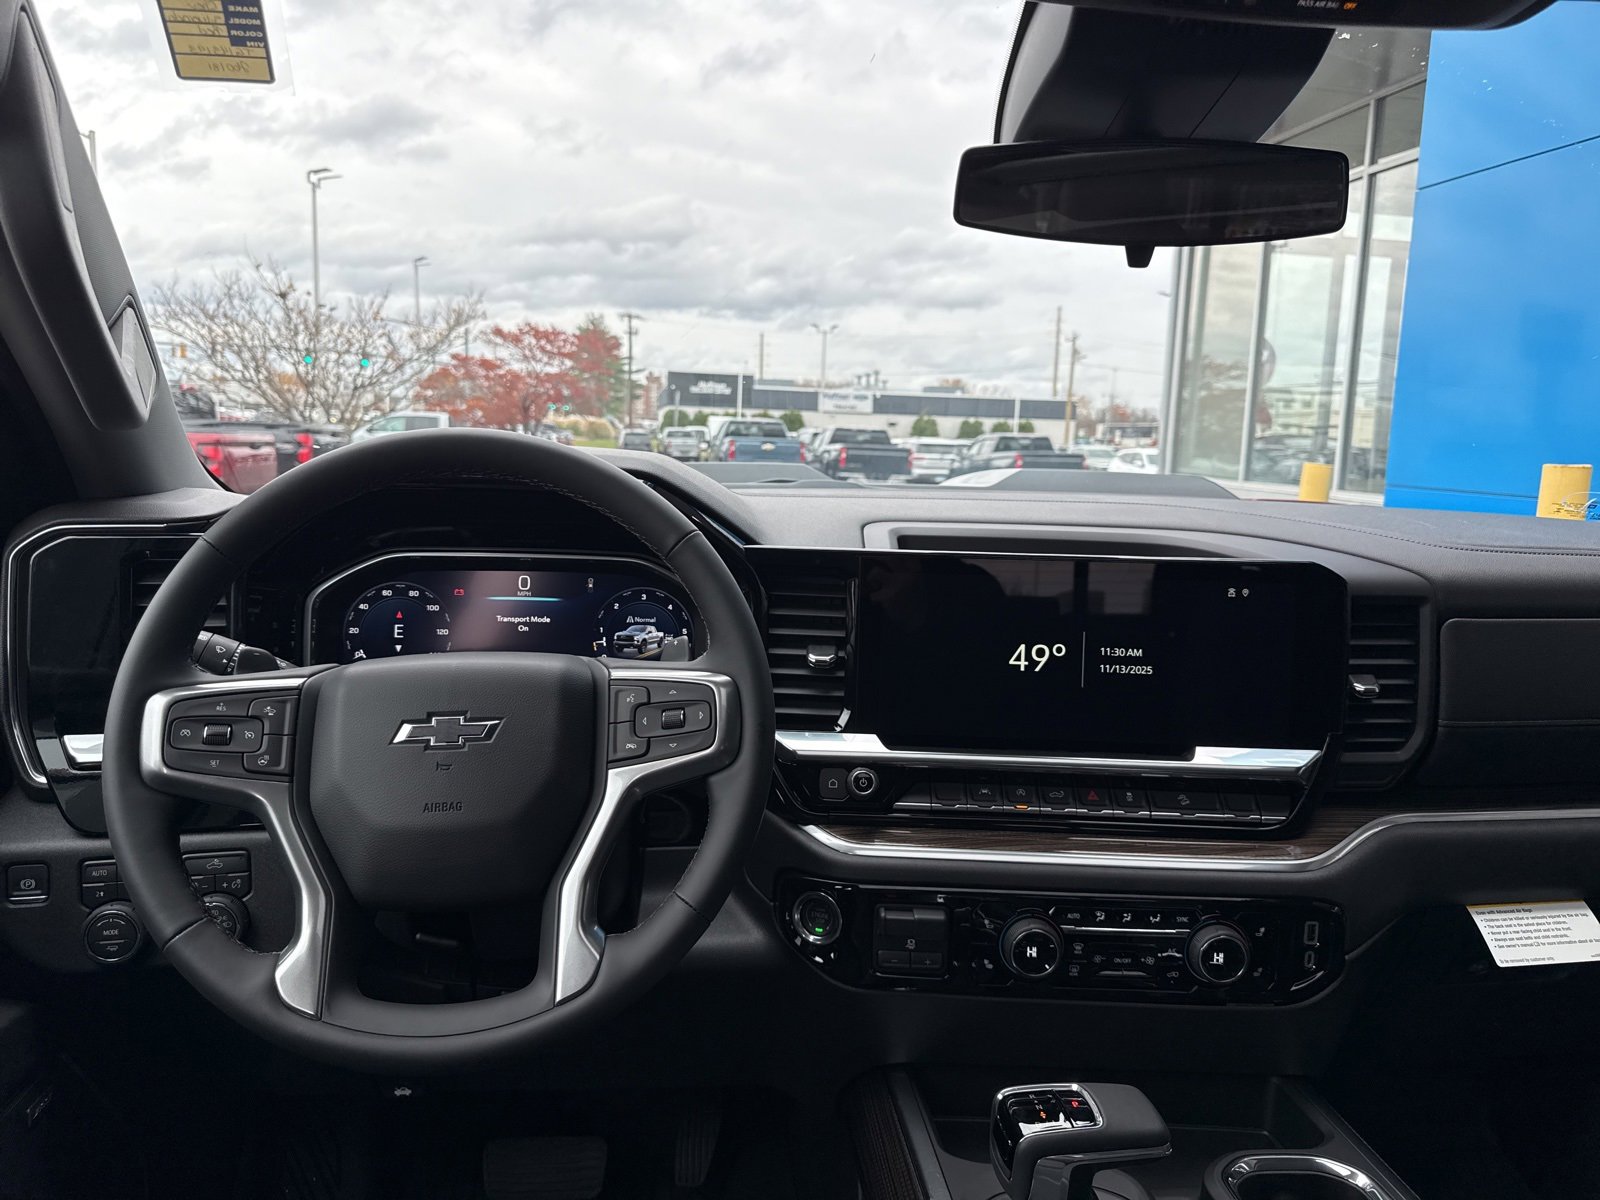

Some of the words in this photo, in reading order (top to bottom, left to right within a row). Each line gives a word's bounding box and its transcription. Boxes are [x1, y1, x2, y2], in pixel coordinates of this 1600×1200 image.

[518, 576, 530, 590] 0
[394, 624, 404, 638] E
[1100, 648, 1126, 657] 11:30
[1127, 648, 1142, 657] AM
[1100, 664, 1153, 675] 11/13/2025
[423, 802, 463, 812] AIRBAG
